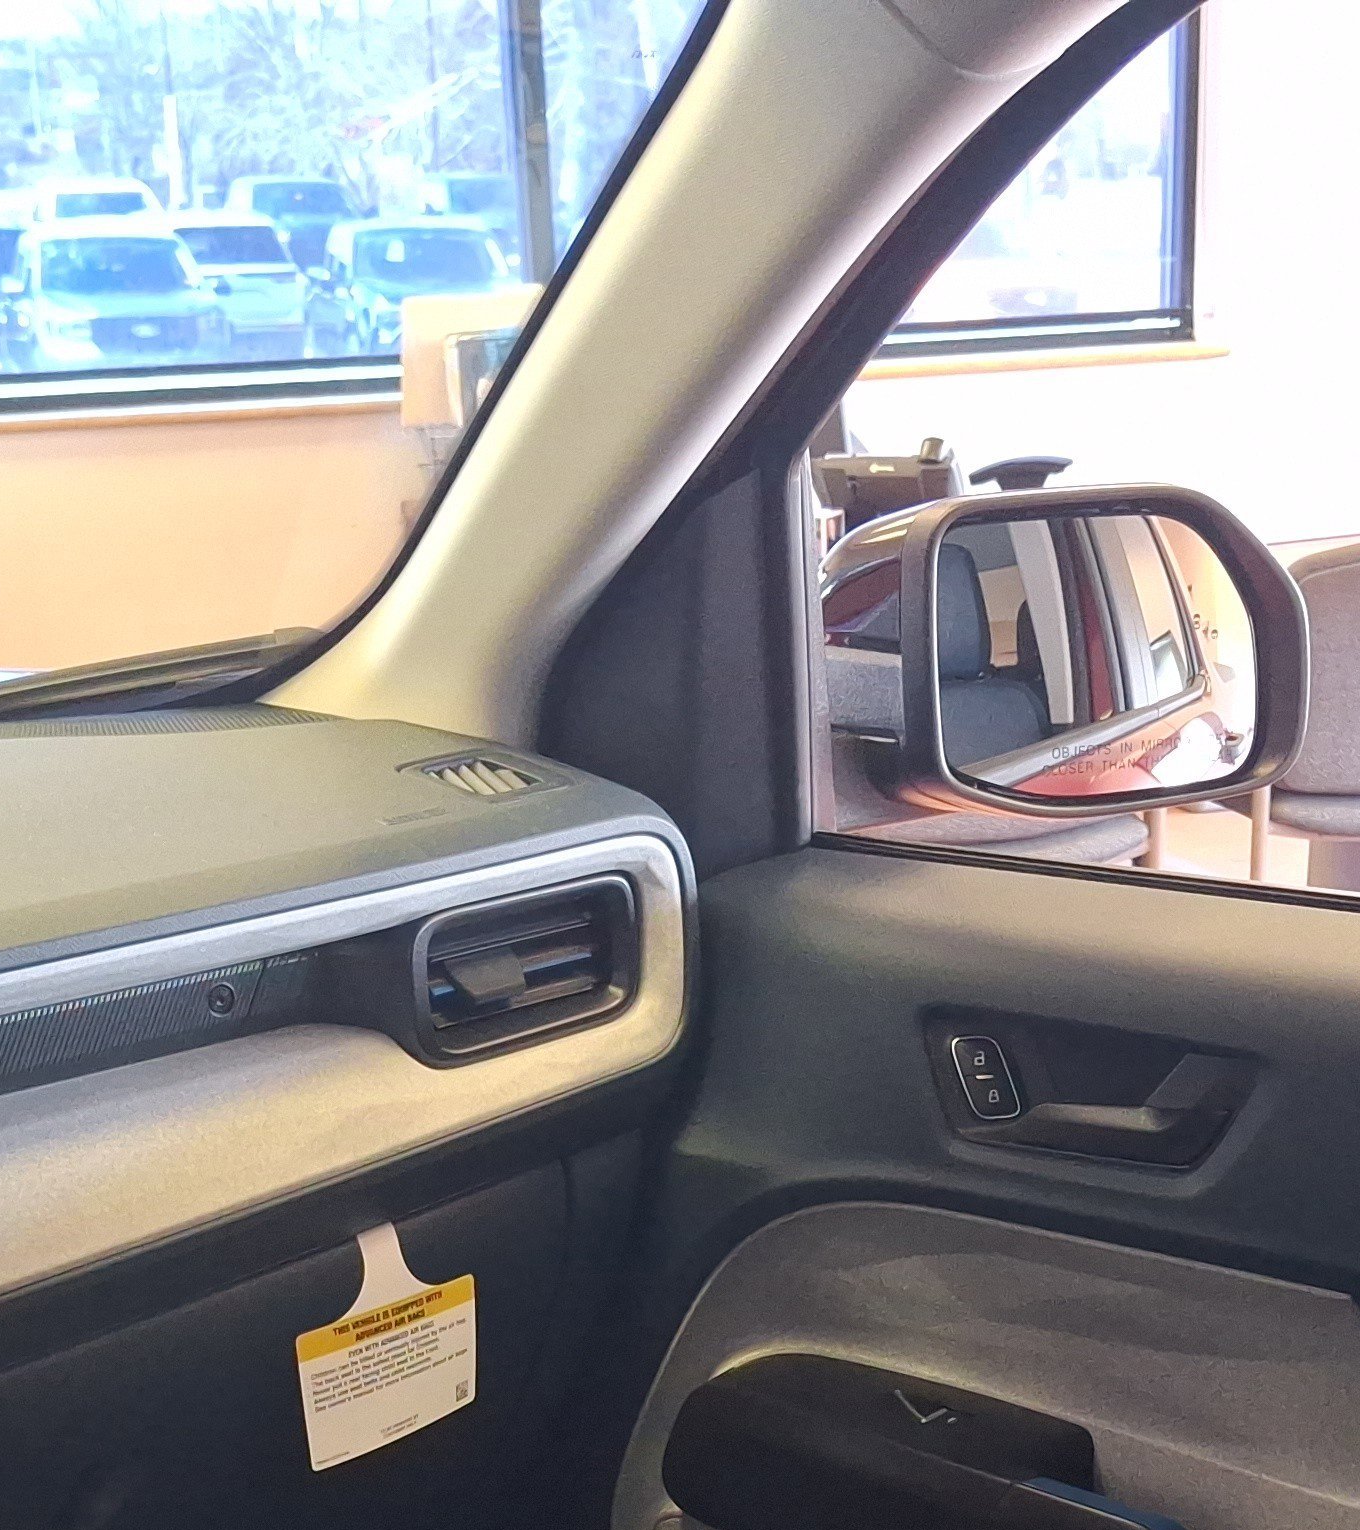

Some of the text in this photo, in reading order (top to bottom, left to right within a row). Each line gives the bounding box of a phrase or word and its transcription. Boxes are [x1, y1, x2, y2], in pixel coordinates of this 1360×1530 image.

[1051, 743, 1112, 760] OBJECTS
[1119, 742, 1134, 753] IN
[1042, 760, 1093, 777] CLOSER
[1102, 757, 1137, 771] THAN
